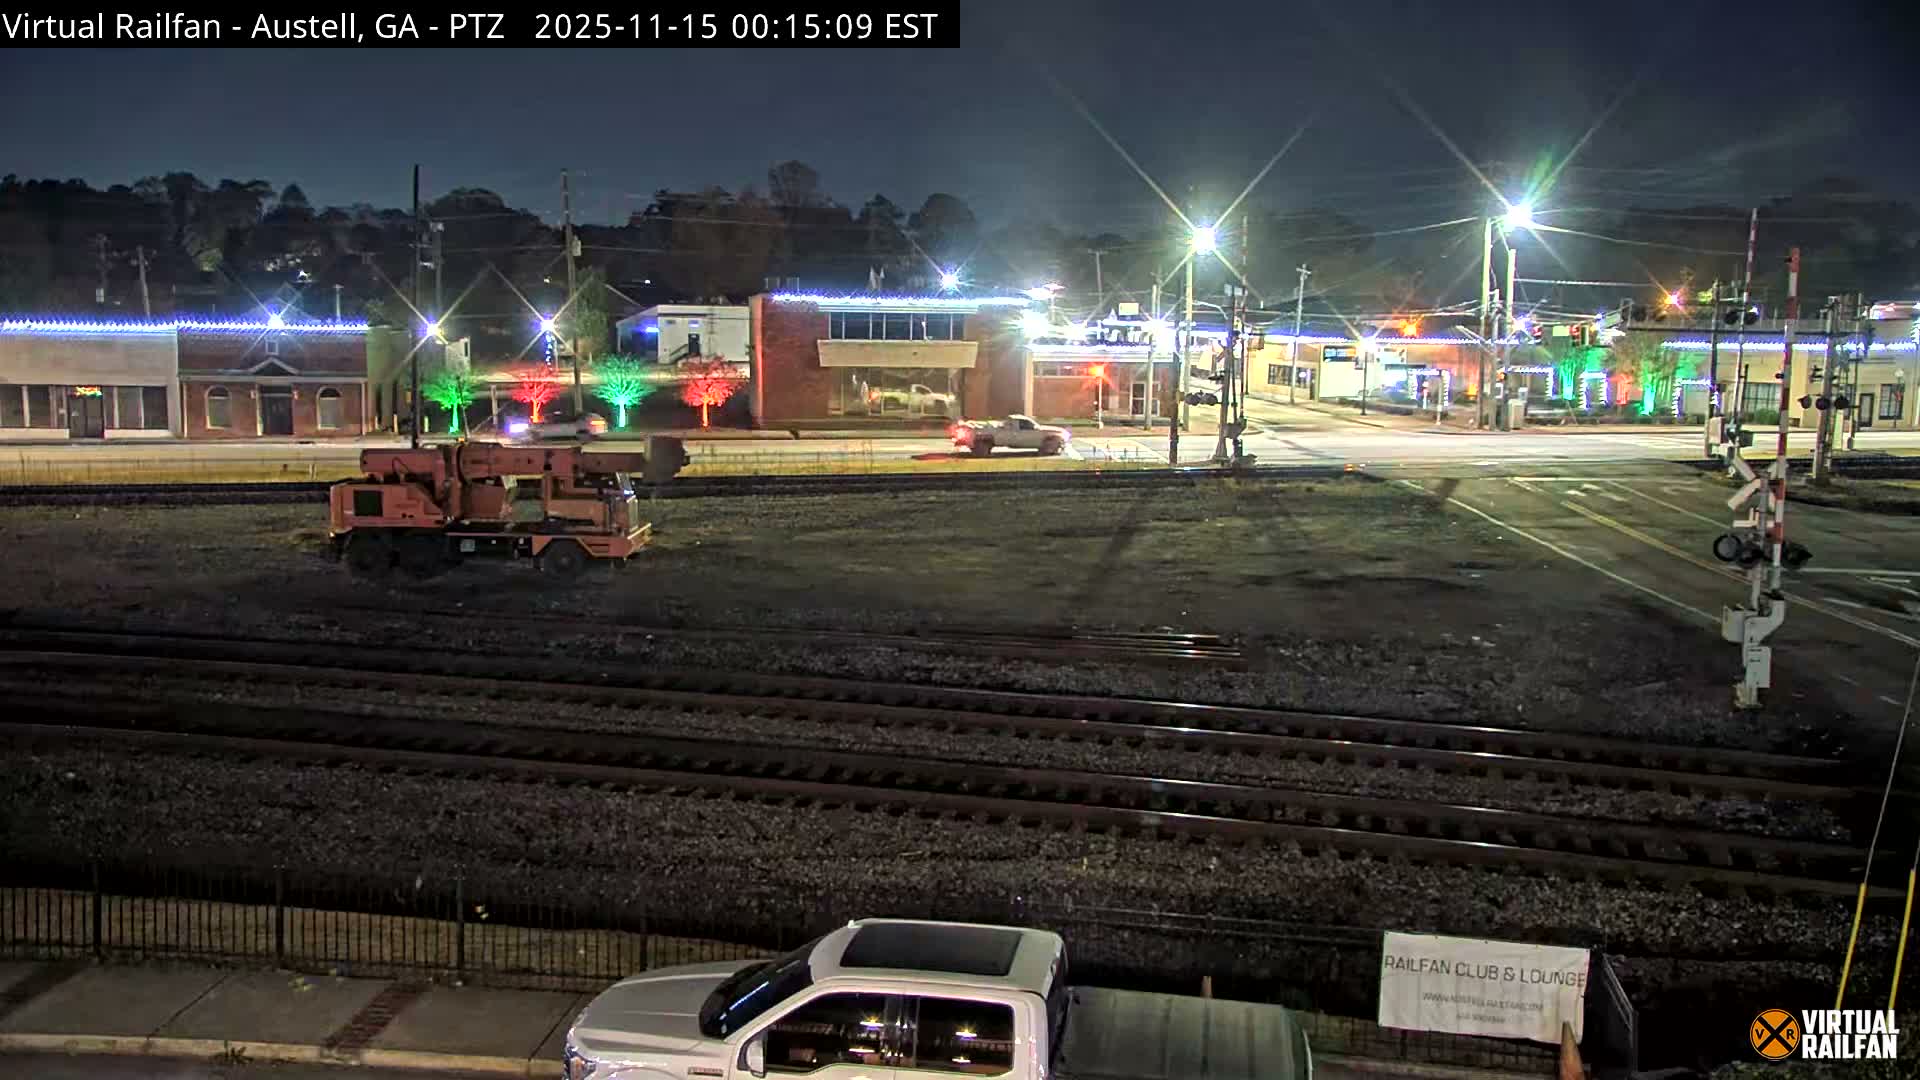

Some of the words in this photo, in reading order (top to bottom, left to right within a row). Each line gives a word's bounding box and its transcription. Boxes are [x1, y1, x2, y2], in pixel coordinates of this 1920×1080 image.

[1384, 954, 1451, 976] RAILFAN
[1455, 961, 1499, 981] CLUB
[1503, 966, 1516, 982] &
[1520, 968, 1587, 988] LOUNGE
